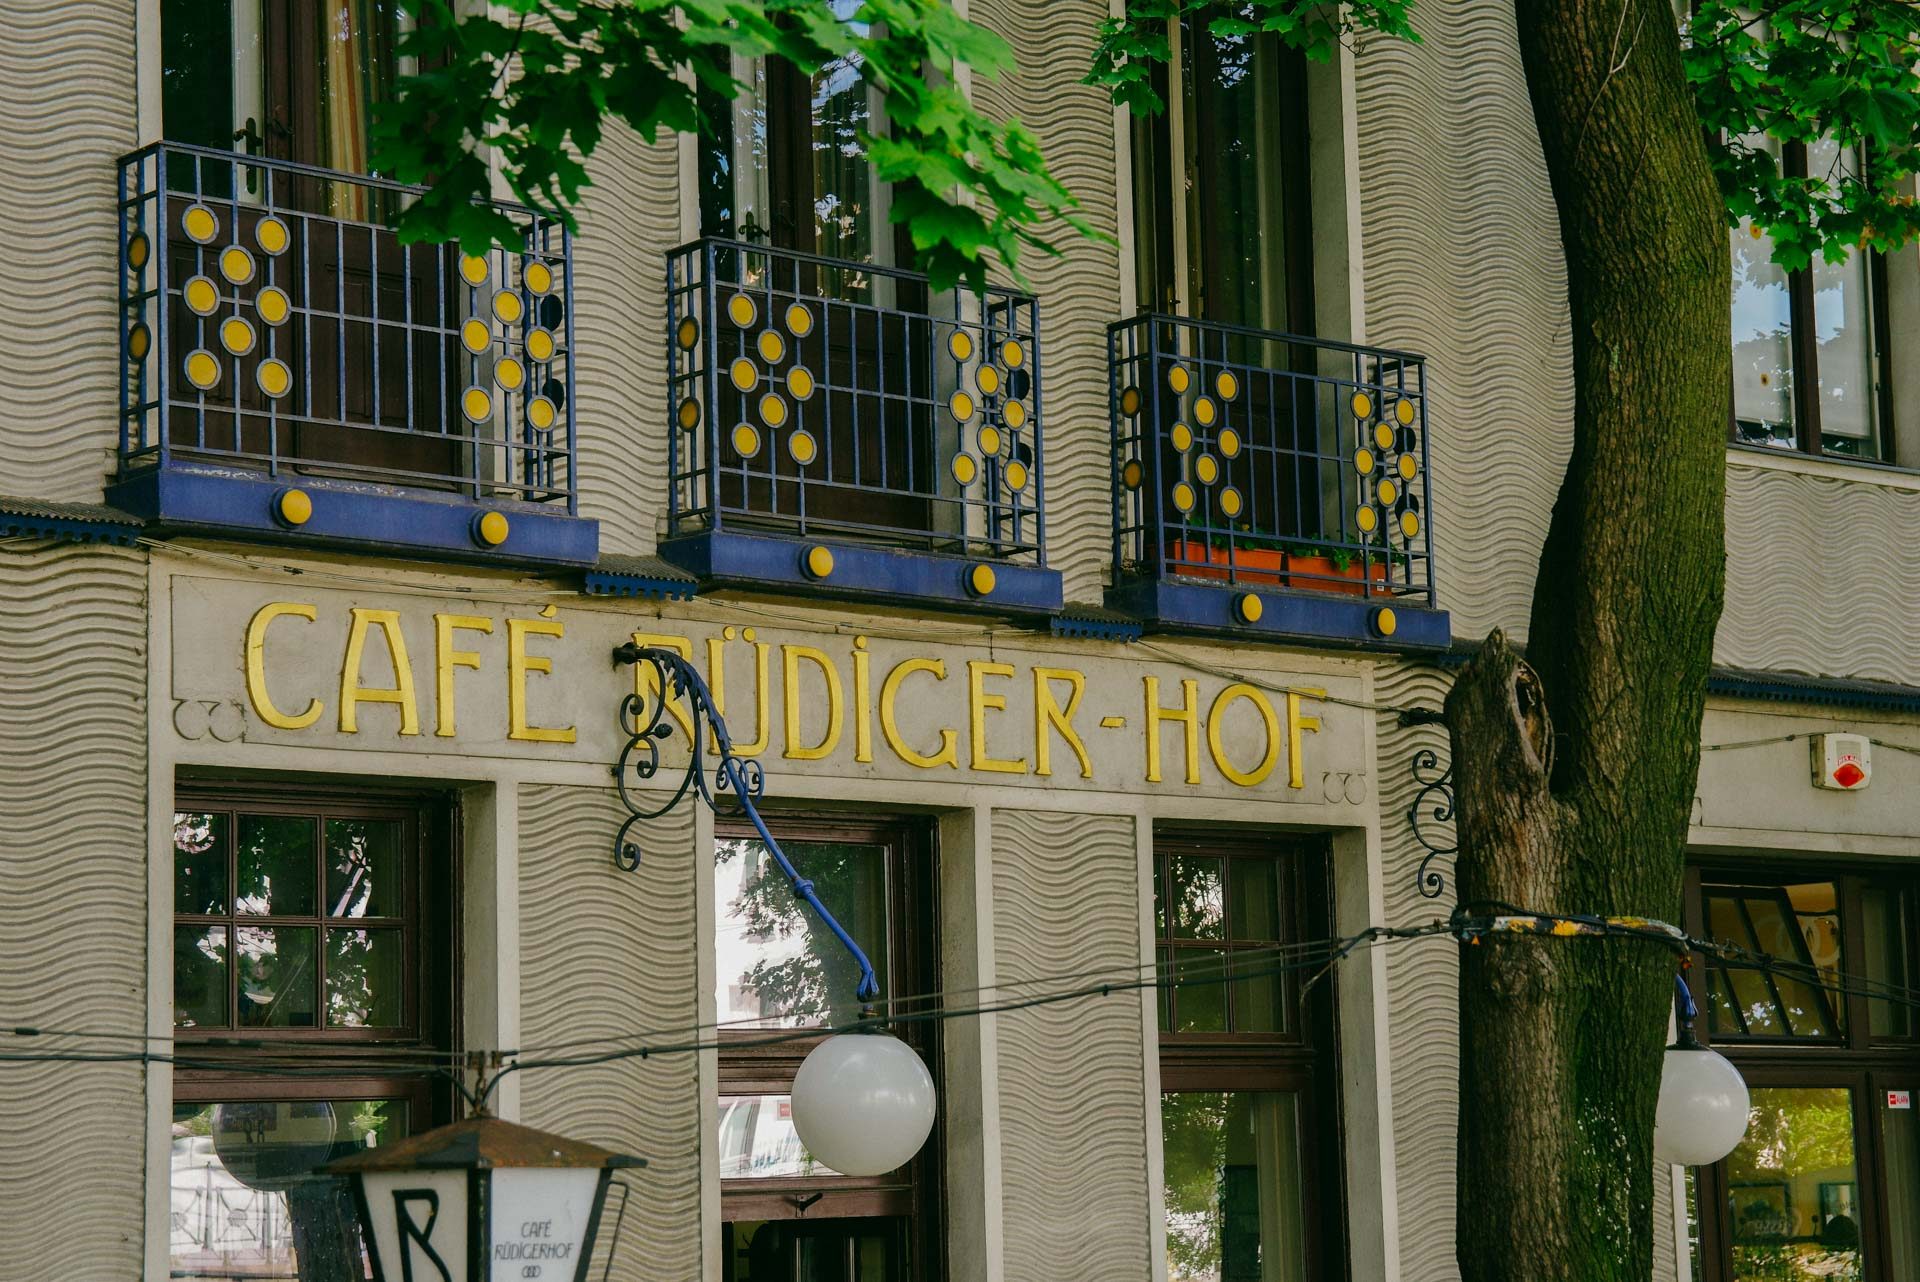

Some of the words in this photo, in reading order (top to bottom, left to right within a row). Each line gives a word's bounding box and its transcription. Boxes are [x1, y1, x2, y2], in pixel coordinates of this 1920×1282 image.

[245, 602, 577, 744] CAFÉ
[392, 1188, 452, 1282] R
[493, 1240, 575, 1261] RÜDIGERHOF
[520, 1218, 553, 1239] CAFÉ
